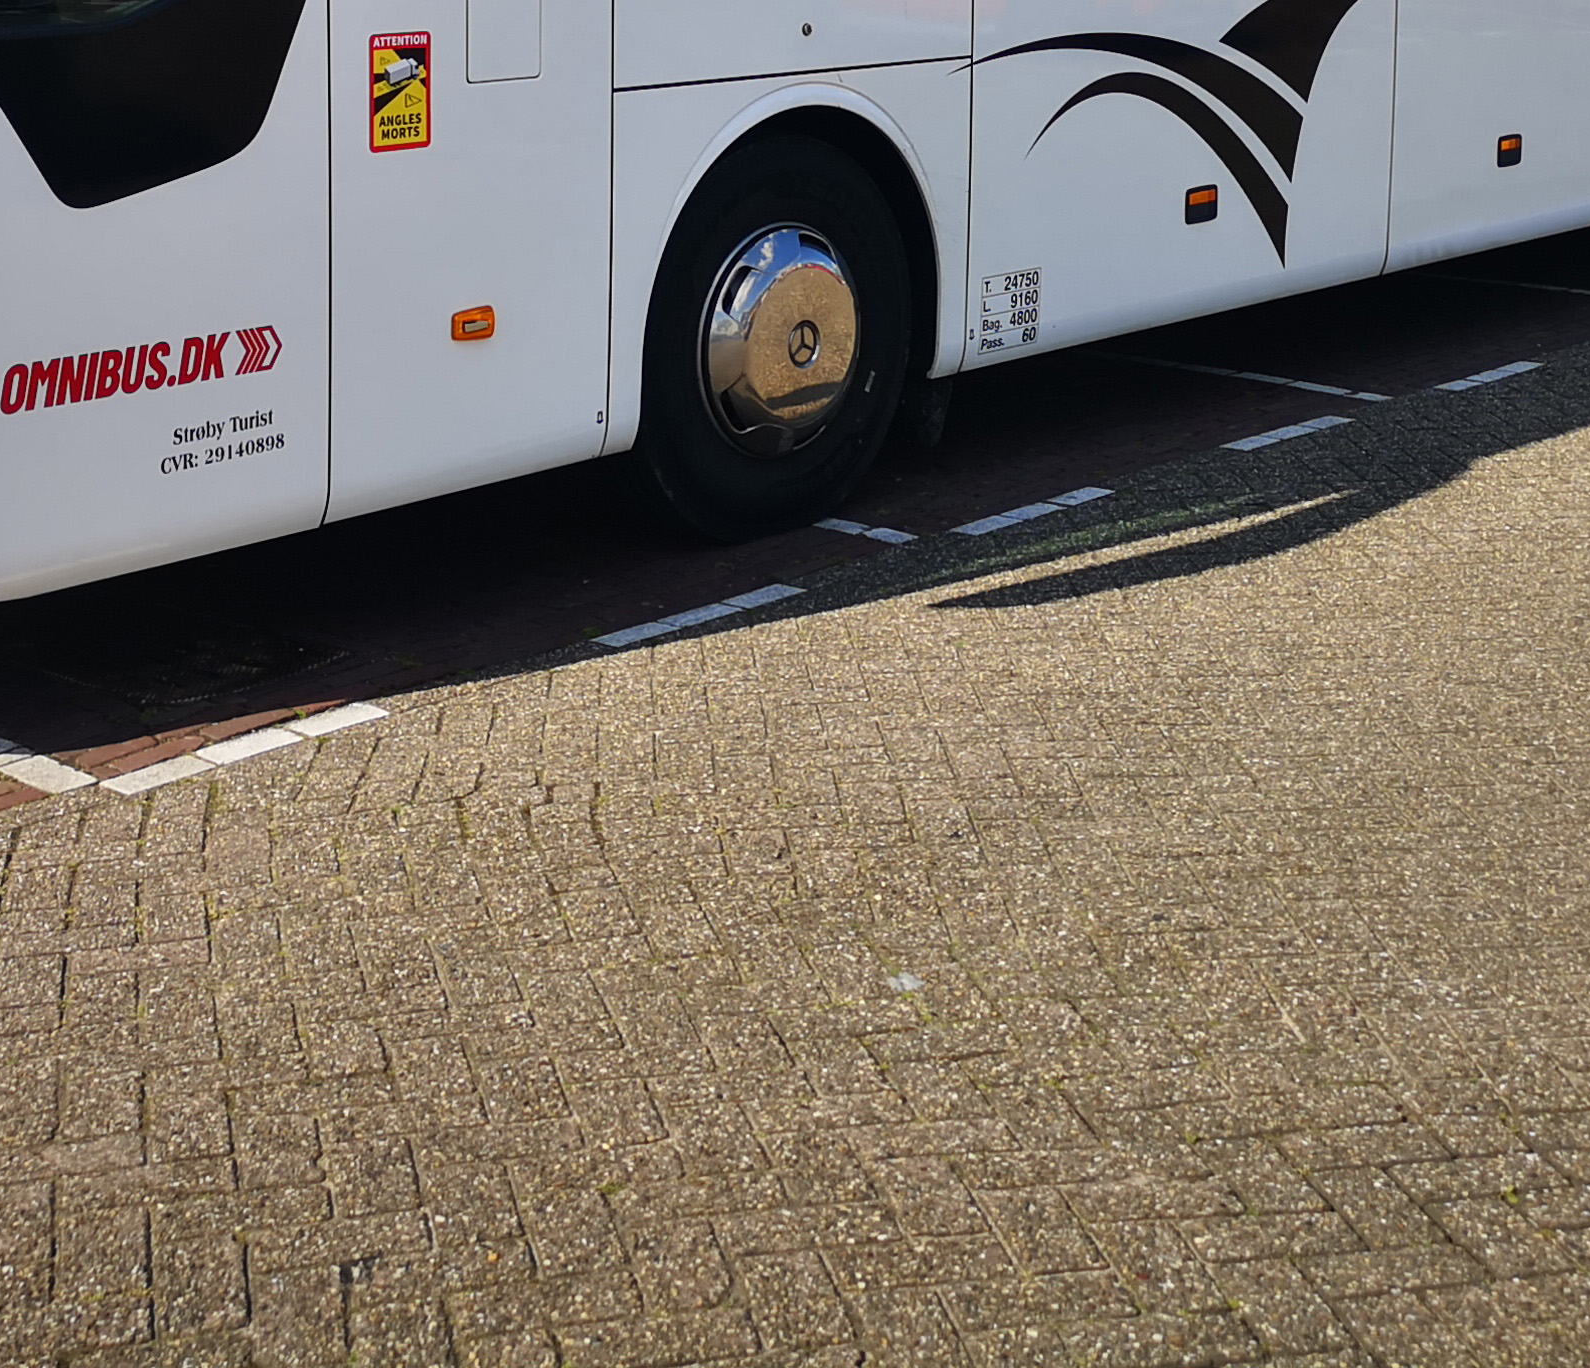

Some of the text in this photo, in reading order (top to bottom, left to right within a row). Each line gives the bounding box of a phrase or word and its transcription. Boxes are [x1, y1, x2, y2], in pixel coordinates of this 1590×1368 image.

[373, 34, 428, 48] ATTENTION
[379, 113, 422, 128] ANGLES
[381, 126, 421, 141] MORTS
[1004, 270, 1039, 291] 24750
[1010, 289, 1039, 309] 9160
[1009, 307, 1038, 326] 4800
[1021, 326, 1037, 343] 60
[0, 331, 231, 415] OMNIBUS.DK
[172, 409, 275, 446] Strøby Turist
[160, 433, 285, 475] CVR: 29140898
